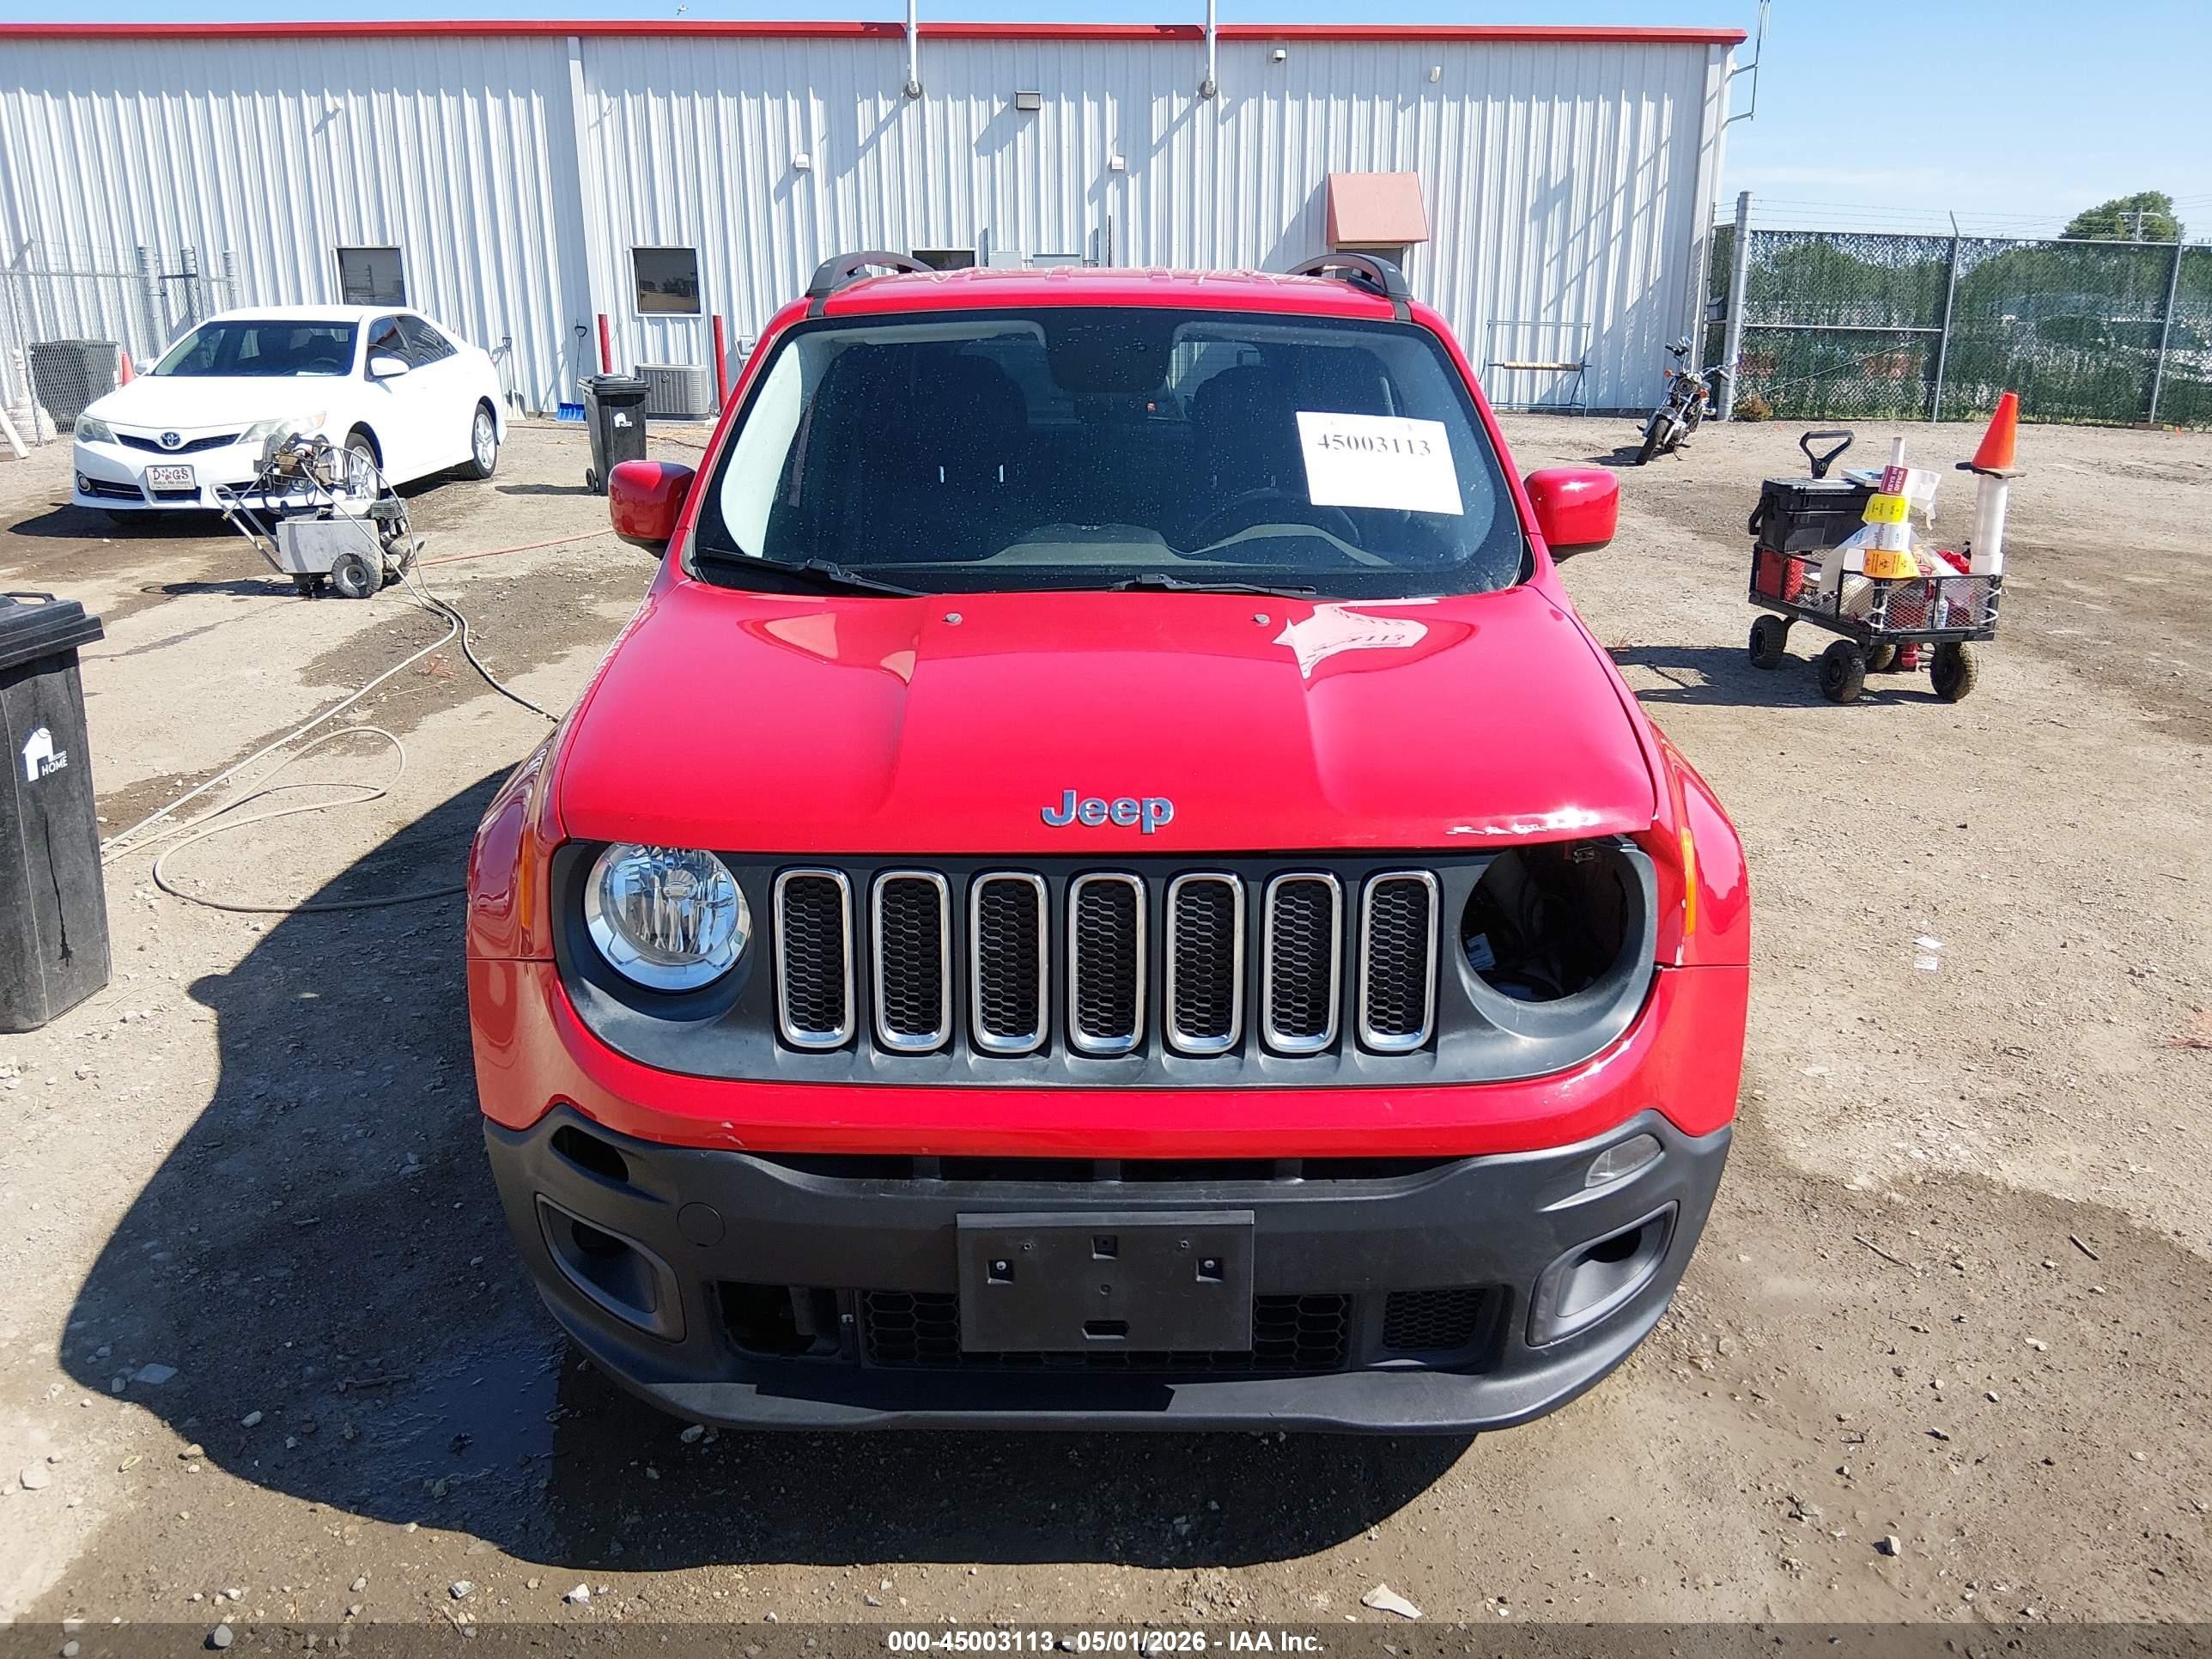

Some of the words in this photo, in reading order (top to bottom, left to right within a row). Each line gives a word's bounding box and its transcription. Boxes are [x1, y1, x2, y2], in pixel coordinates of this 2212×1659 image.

[1318, 433, 1431, 457] 45003113
[153, 467, 189, 480] DGS
[1894, 471, 1905, 491] OFFICE
[1887, 476, 1896, 492] KEYS
[41, 756, 68, 776] HOME
[1042, 789, 1175, 834] Jeep
